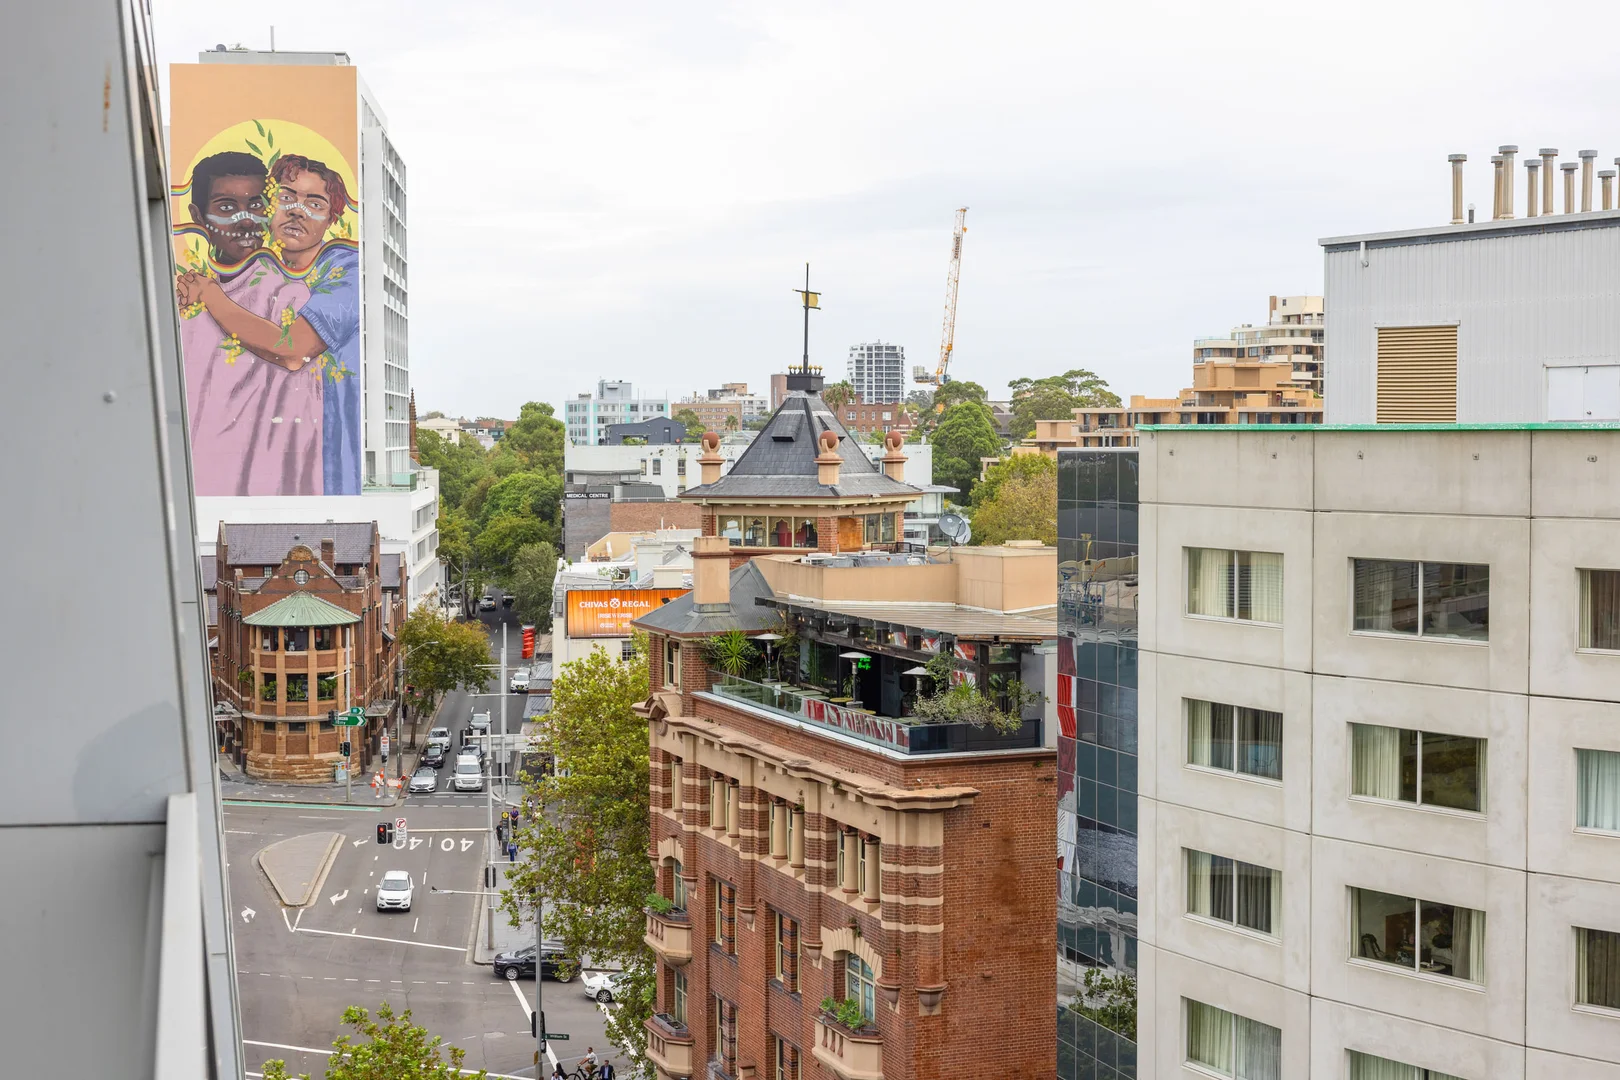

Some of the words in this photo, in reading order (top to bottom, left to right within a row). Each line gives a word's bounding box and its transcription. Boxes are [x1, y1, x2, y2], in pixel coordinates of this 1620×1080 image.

[231, 211, 254, 222] STILL
[285, 202, 312, 217] THRIVING
[622, 600, 651, 608] REGAL
